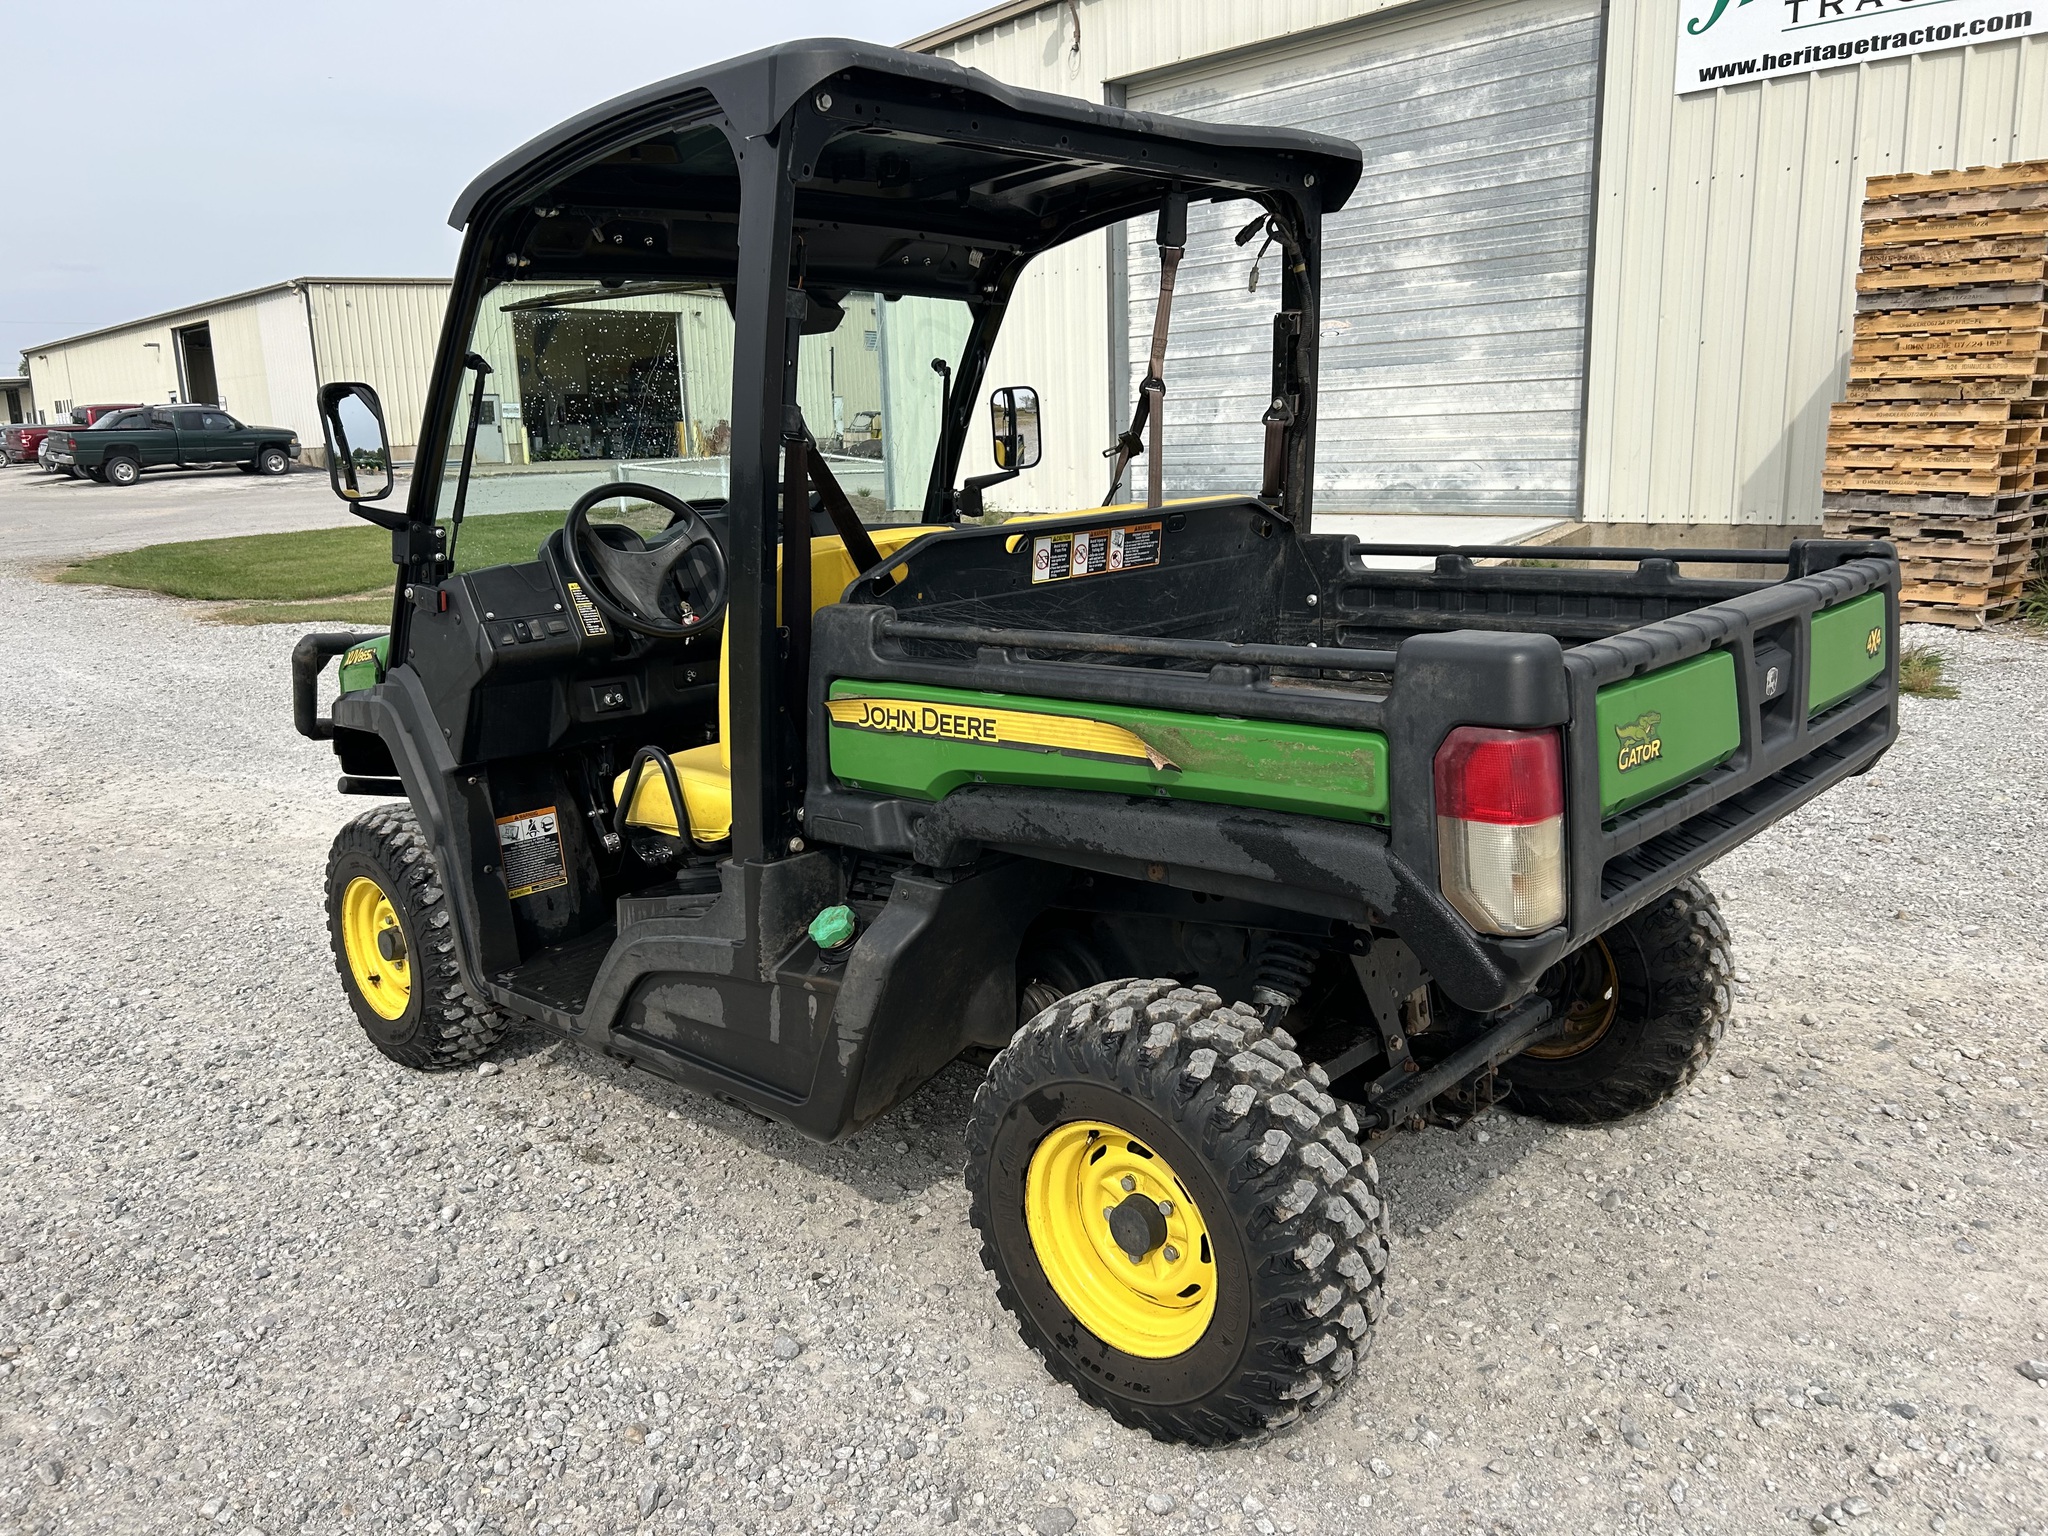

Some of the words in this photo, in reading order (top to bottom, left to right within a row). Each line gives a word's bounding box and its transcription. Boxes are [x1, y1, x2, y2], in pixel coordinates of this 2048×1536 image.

[1698, 10, 2033, 83] www.heritagetractor.com
[859, 703, 917, 730] JOHN
[922, 707, 998, 740] DEERE
[1618, 738, 1661, 770] GATOR
